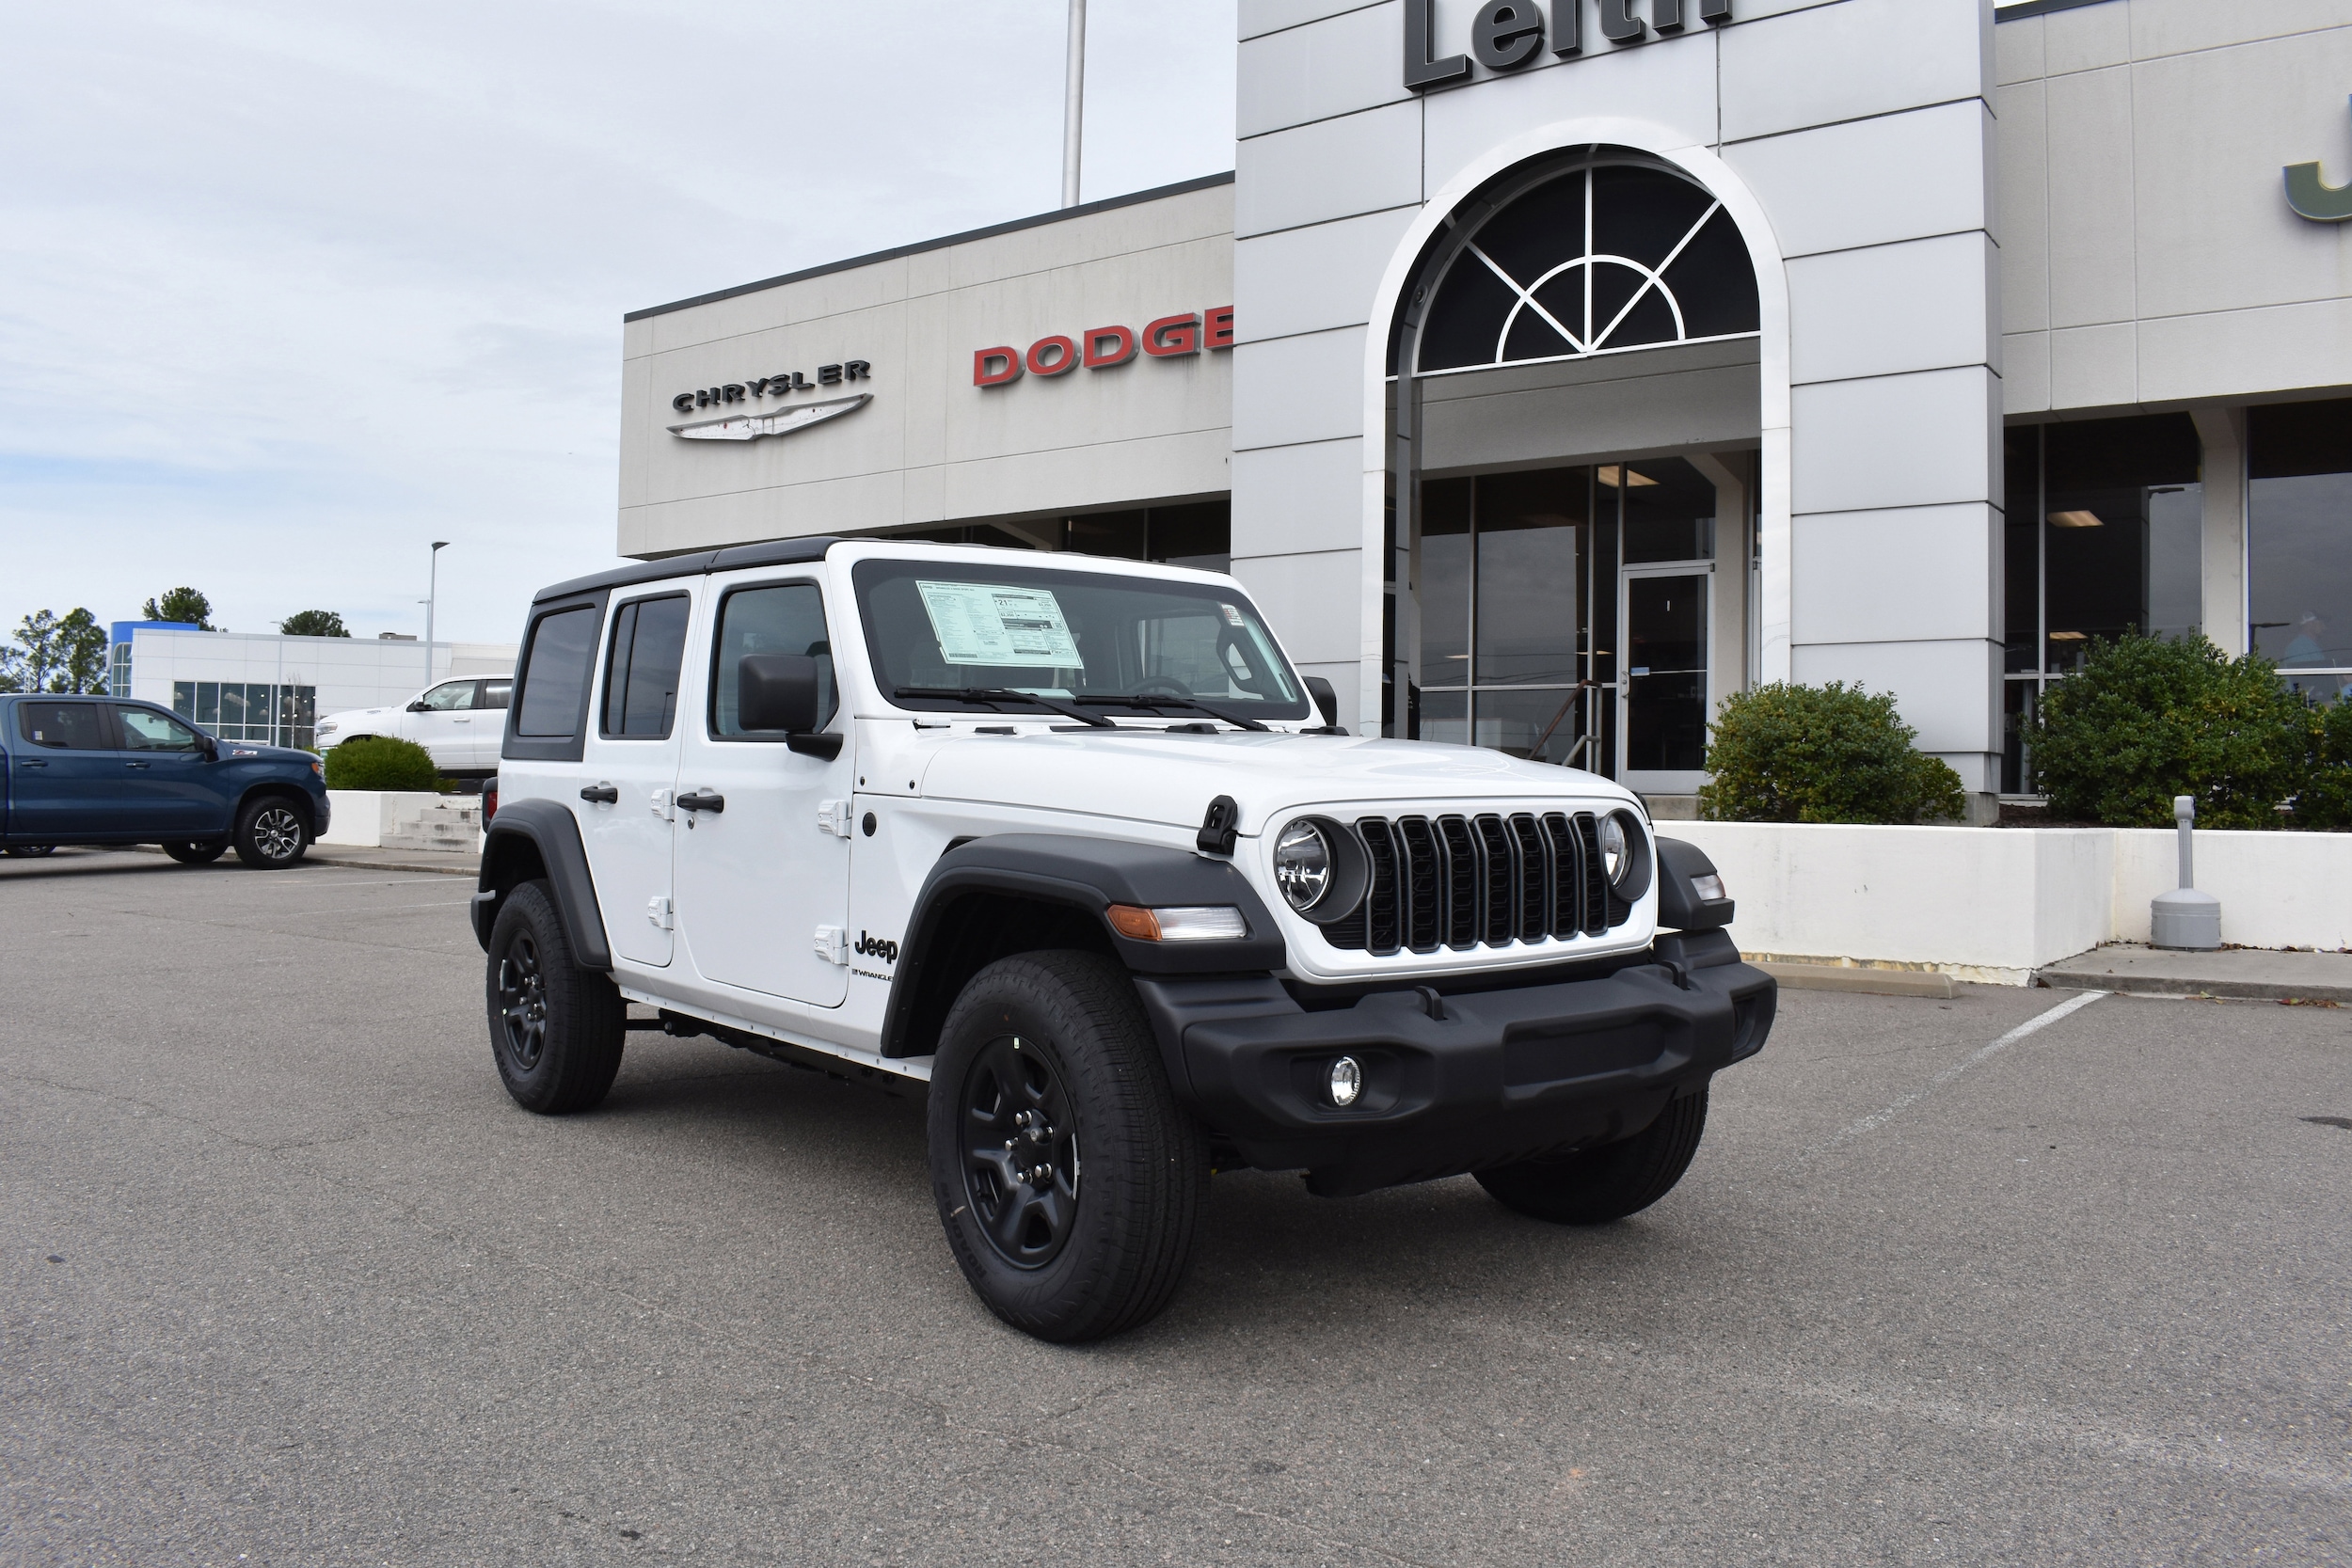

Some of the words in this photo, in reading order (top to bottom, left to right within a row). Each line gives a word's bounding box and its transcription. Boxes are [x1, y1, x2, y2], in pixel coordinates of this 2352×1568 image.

[974, 305, 1233, 388] DODGE
[673, 359, 871, 412] CHRYSLER
[854, 929, 898, 964] Jeep
[858, 969, 894, 982] WRANGLE
